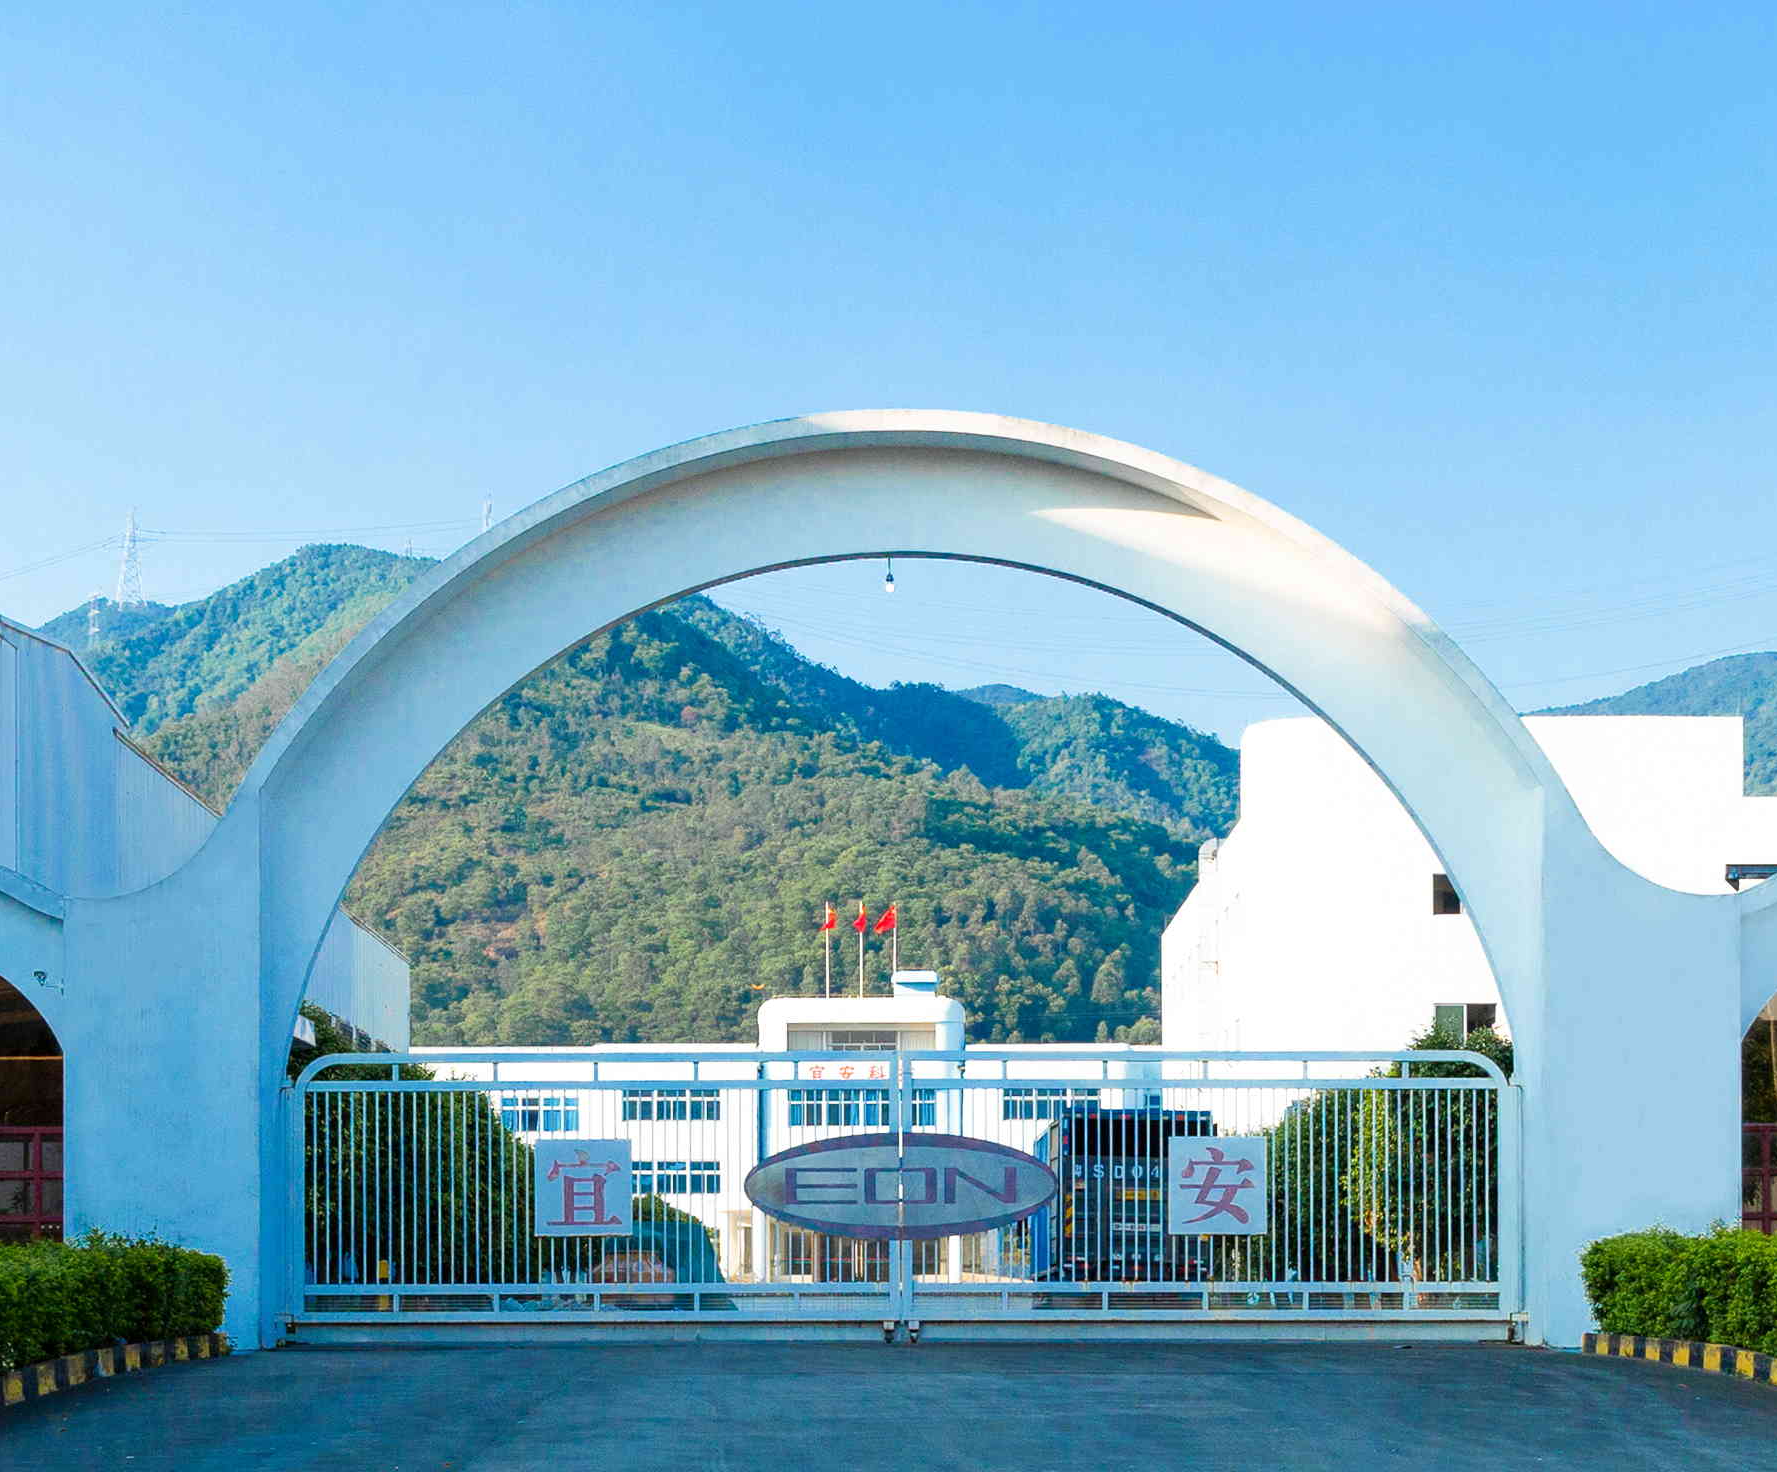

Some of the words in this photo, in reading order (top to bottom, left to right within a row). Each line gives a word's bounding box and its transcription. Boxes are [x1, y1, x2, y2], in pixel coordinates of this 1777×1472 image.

[809, 1065, 915, 1080] 宜安科
[546, 1149, 623, 1226] 宜
[784, 1167, 1017, 1204] EON
[1179, 1147, 1255, 1225] 安
